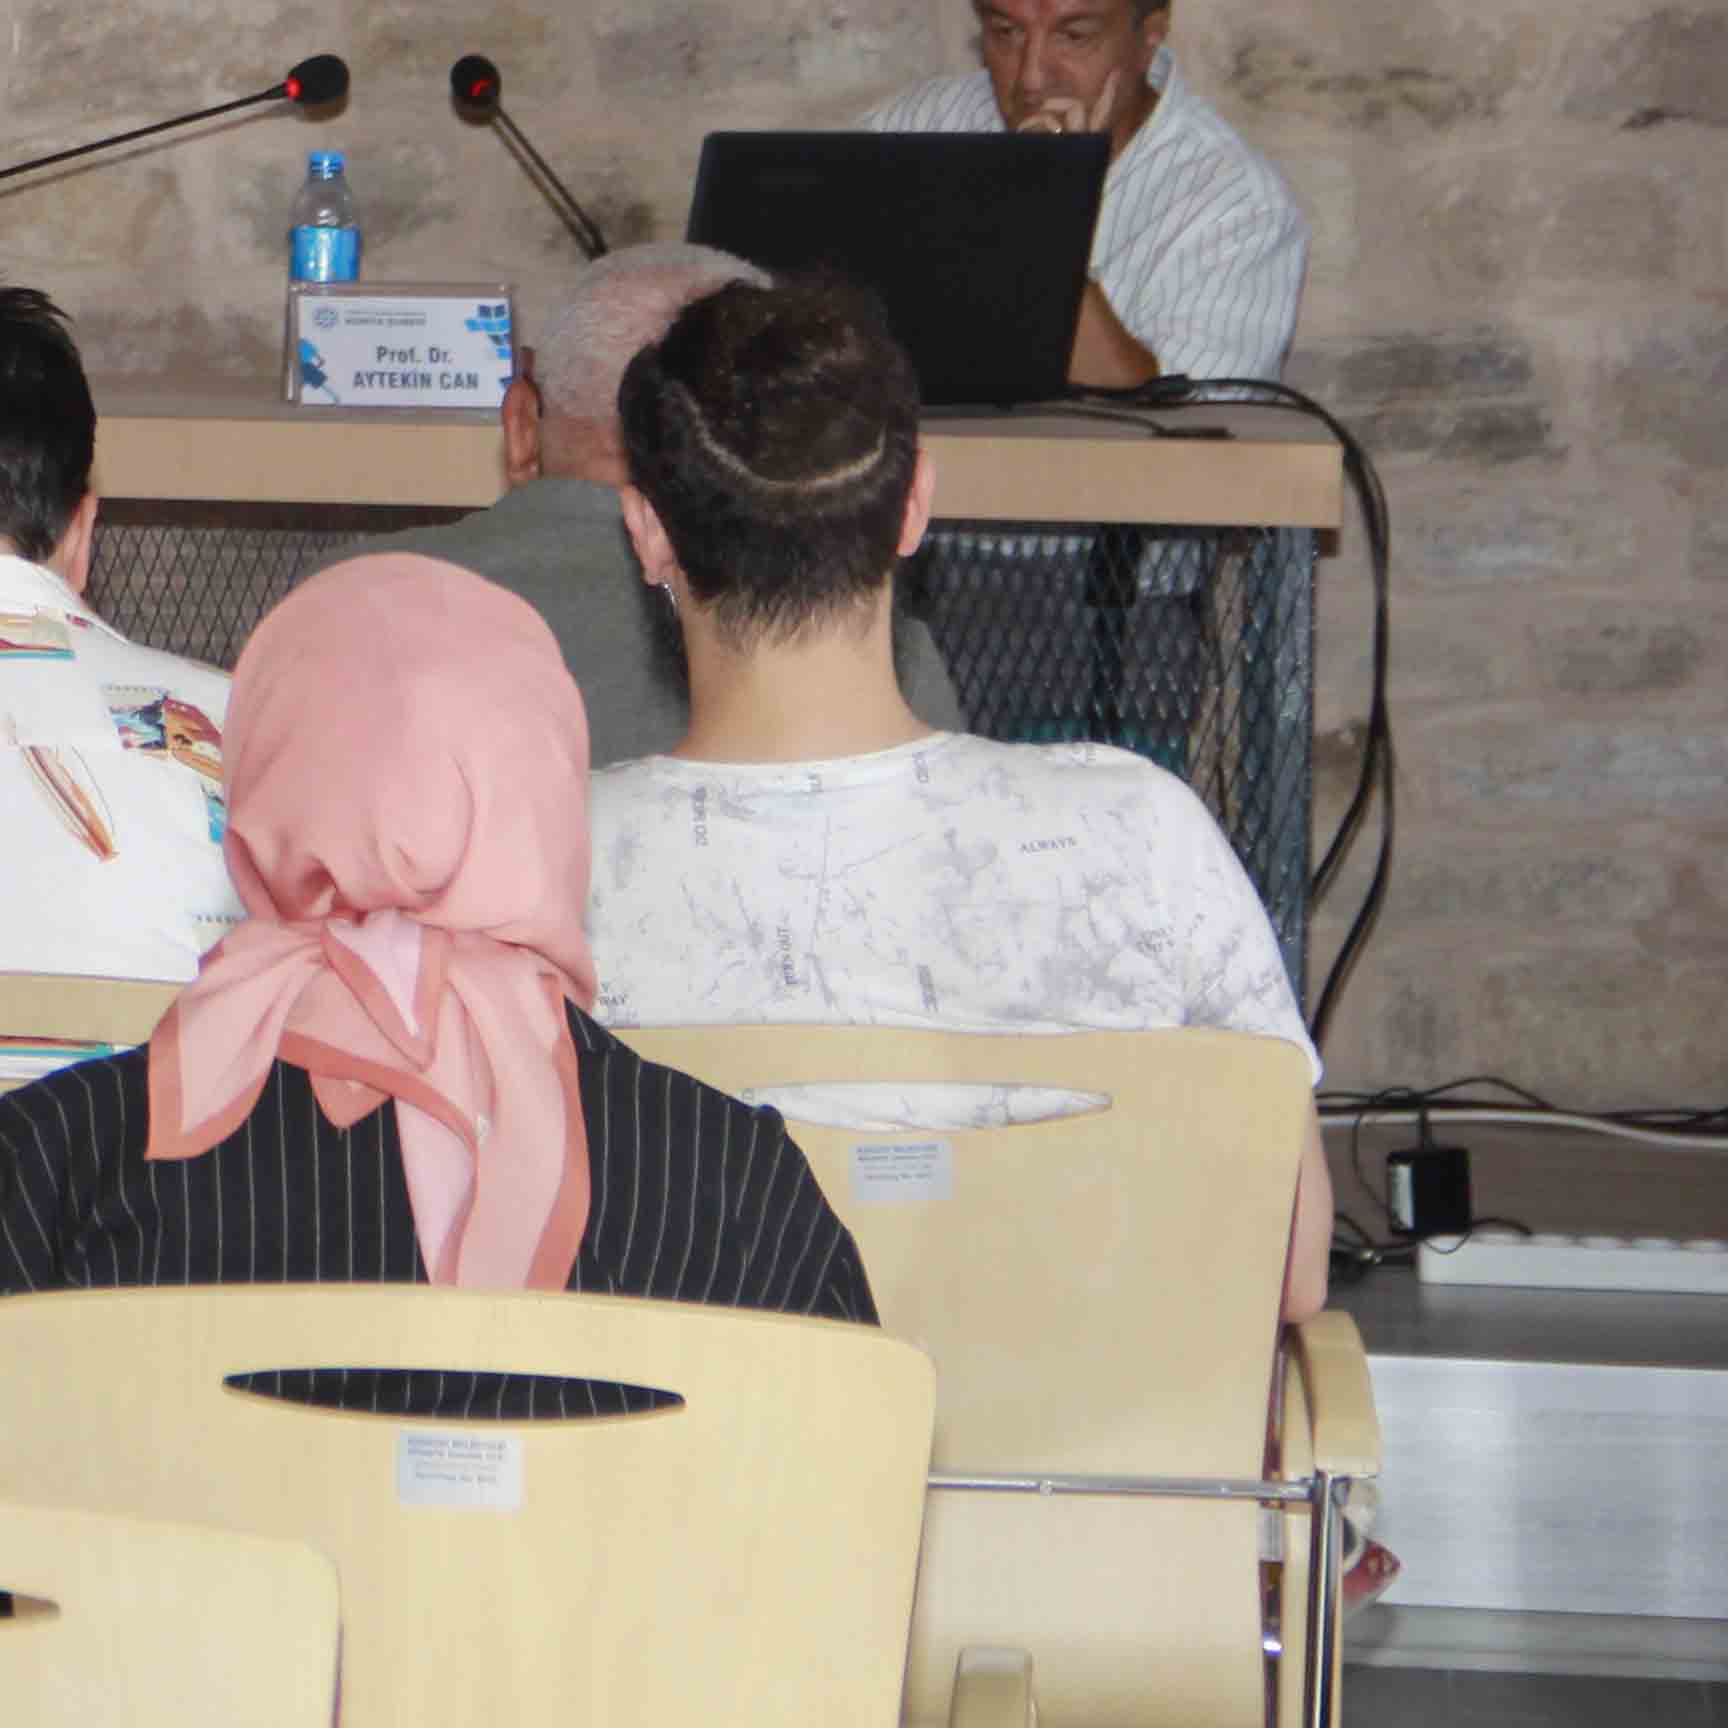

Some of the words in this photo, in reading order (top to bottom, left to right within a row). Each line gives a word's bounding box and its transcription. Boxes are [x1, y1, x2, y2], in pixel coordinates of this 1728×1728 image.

[376, 345, 422, 364] Prof.
[428, 346, 454, 364] Dr.
[439, 371, 479, 390] CAN
[1019, 835, 1079, 854] ALWAYS
